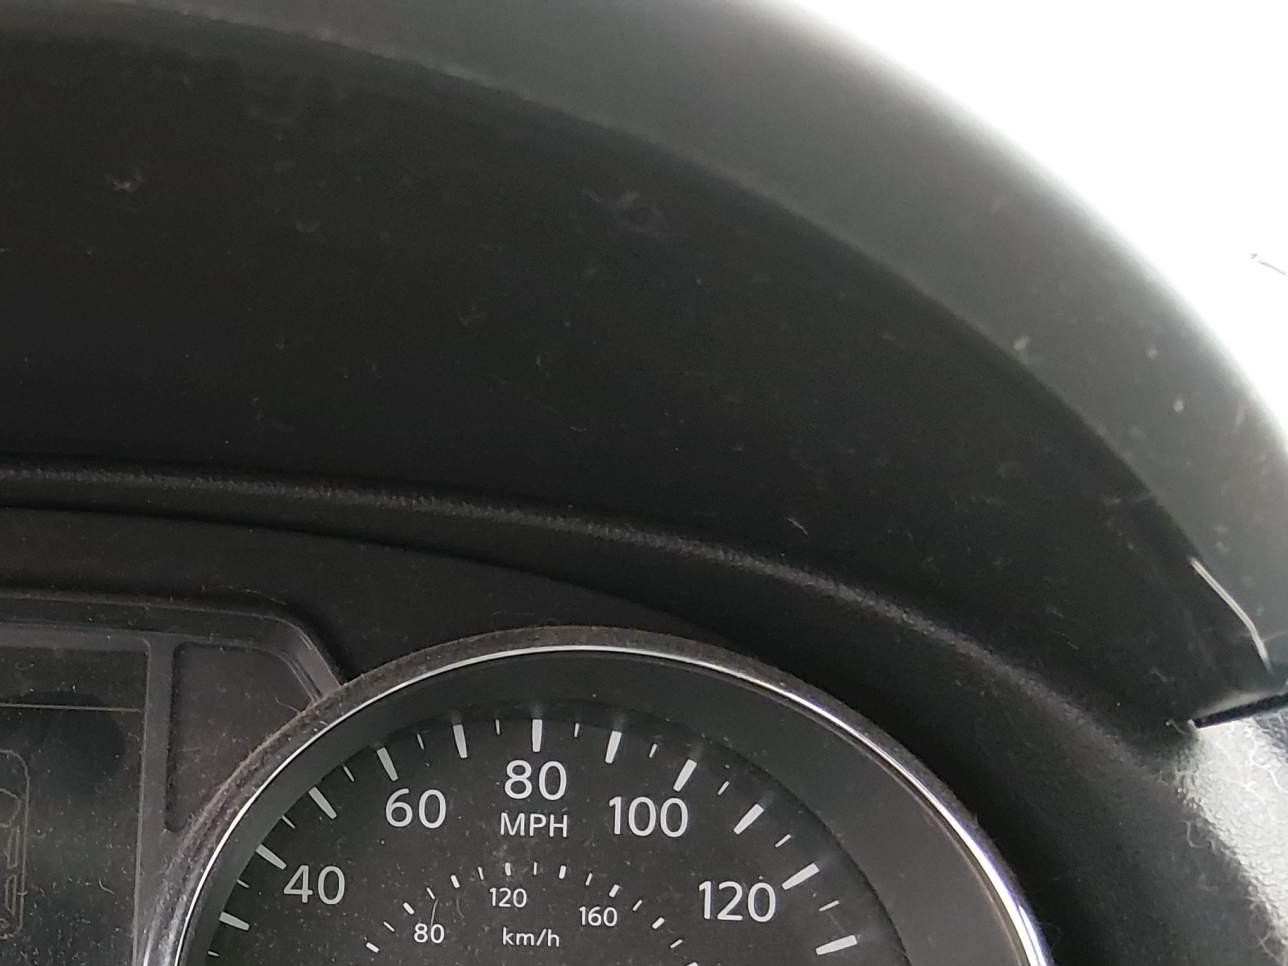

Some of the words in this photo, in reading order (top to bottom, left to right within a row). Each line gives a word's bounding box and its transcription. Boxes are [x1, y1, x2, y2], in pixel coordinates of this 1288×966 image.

[504, 759, 567, 801] 80
[385, 788, 447, 829] 60
[500, 812, 568, 838] MPH
[608, 796, 689, 838] 100
[282, 864, 346, 905] 40
[489, 887, 528, 908] 120
[579, 906, 618, 927] 160
[698, 880, 776, 923] 120
[413, 922, 445, 944] 80
[502, 926, 560, 948] km/h
